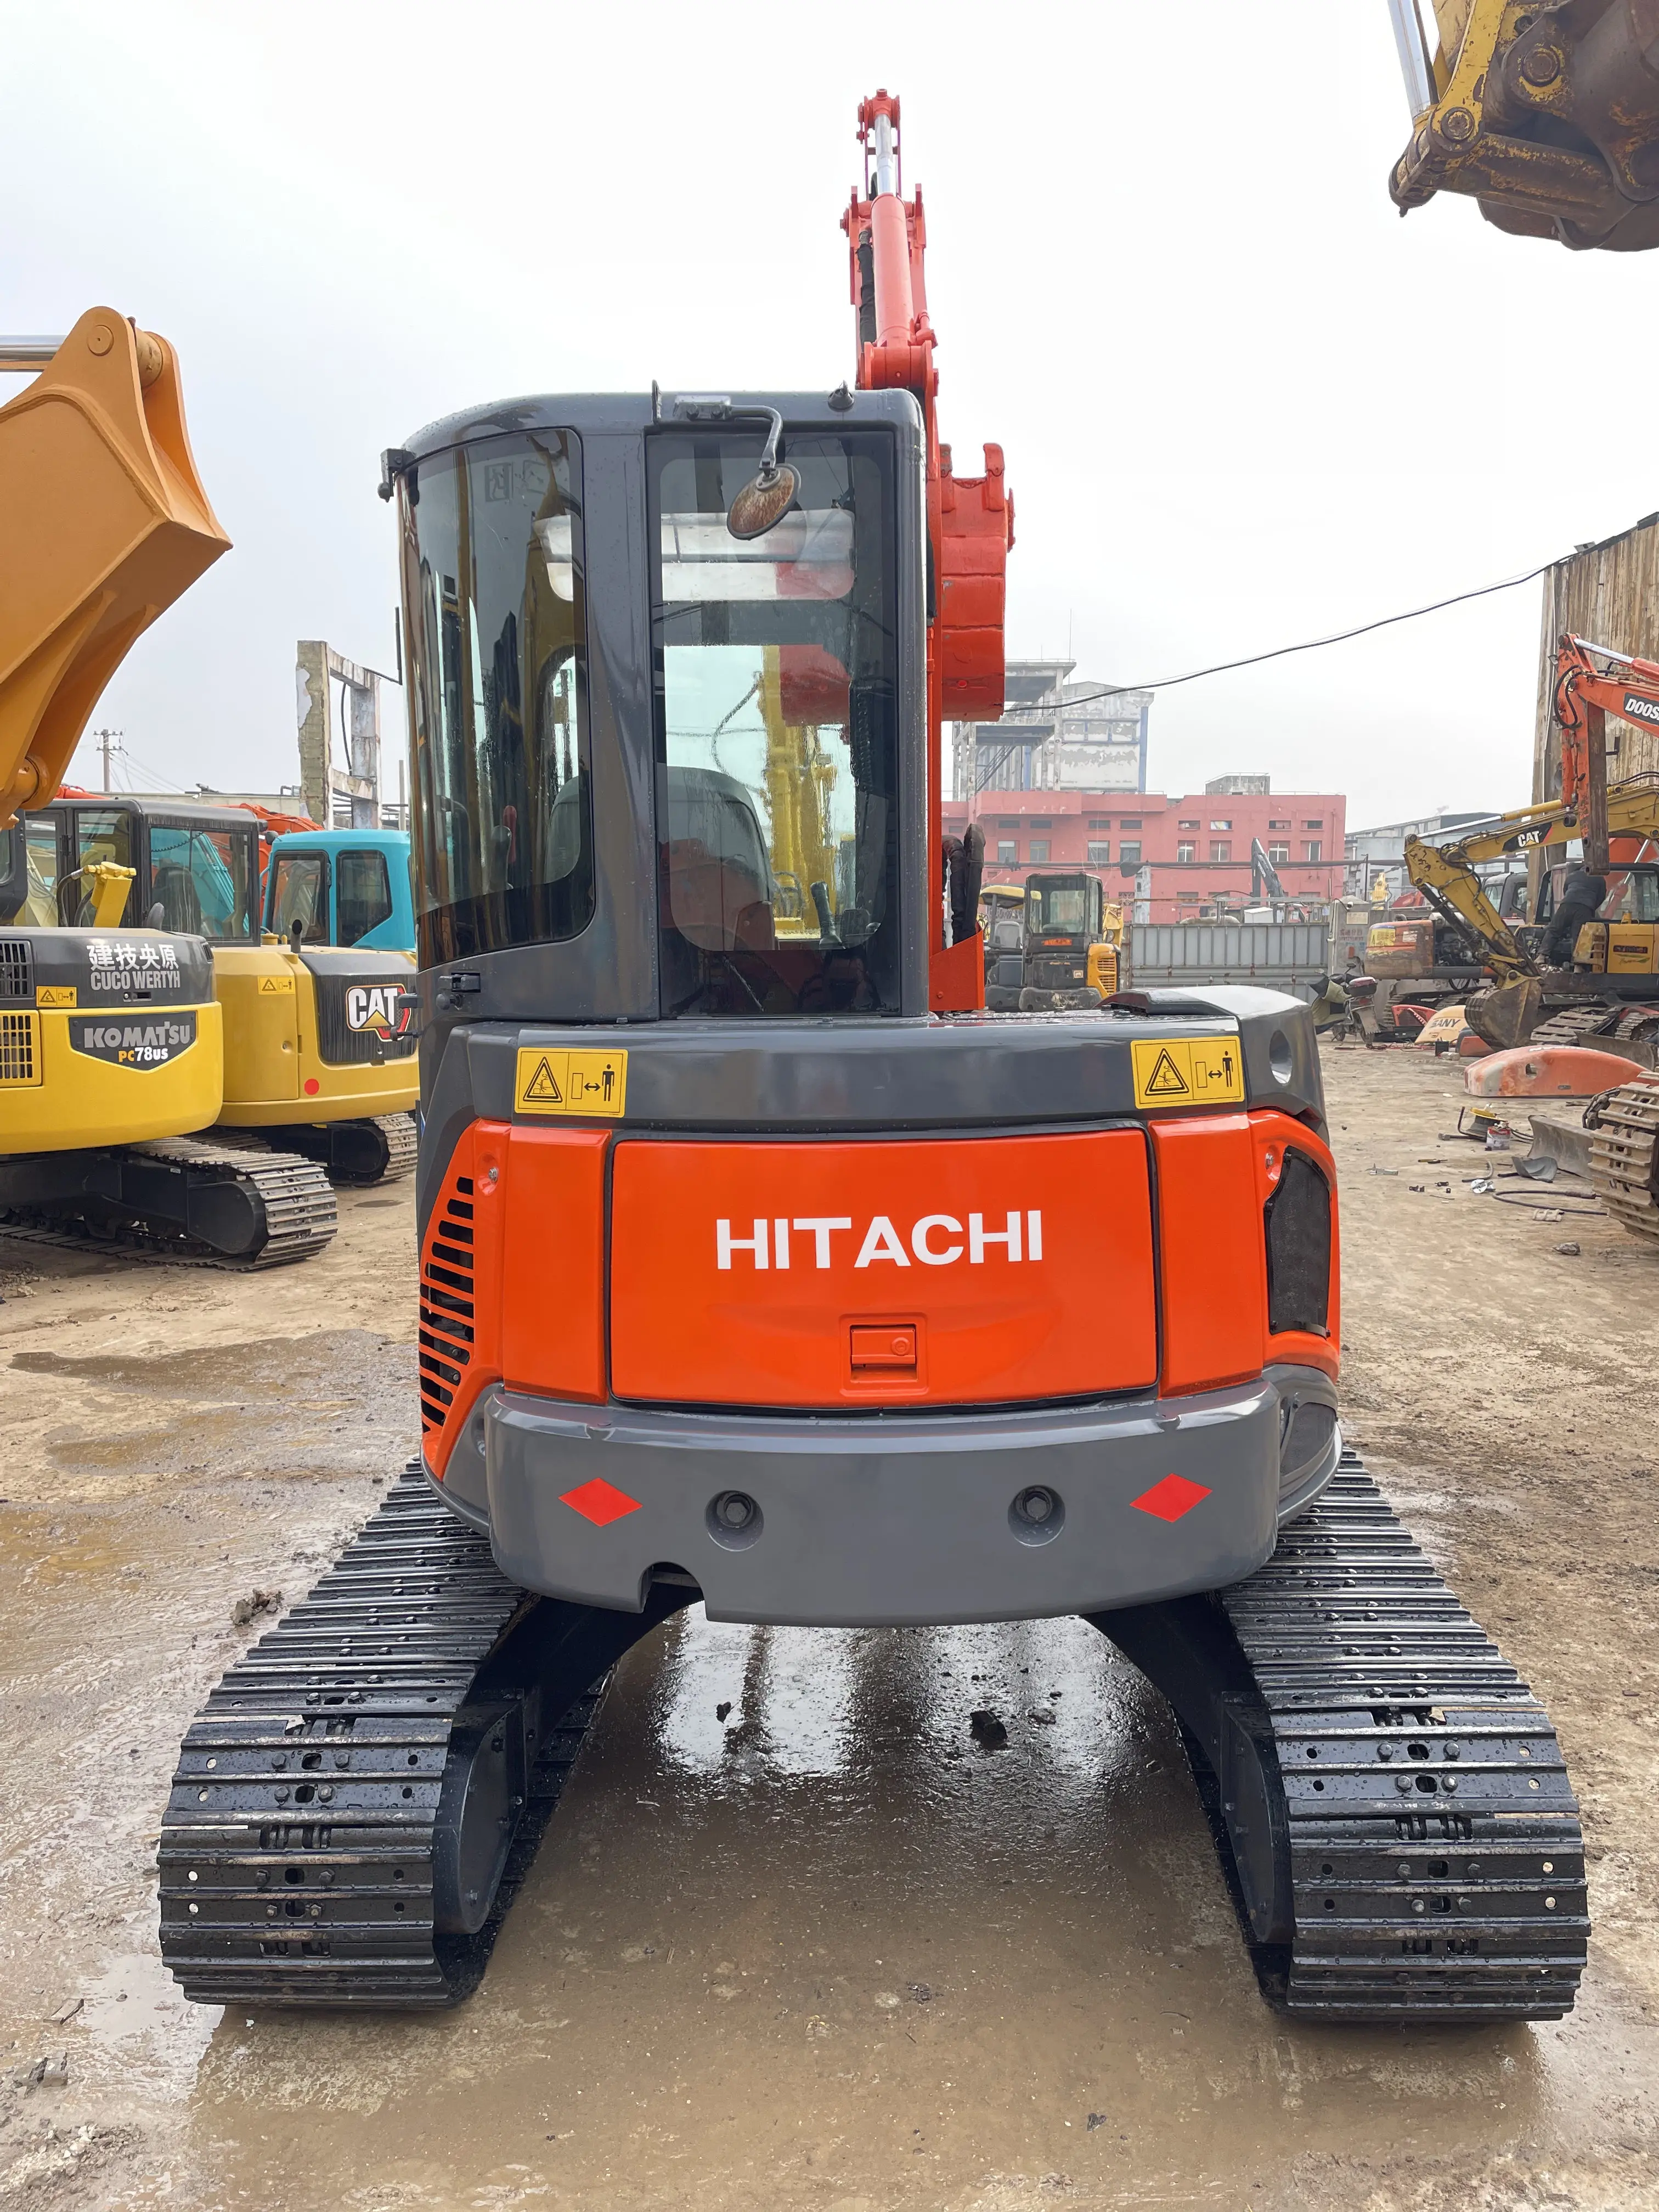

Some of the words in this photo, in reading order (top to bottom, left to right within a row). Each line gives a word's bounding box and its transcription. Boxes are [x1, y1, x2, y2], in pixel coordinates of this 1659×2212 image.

[1625, 698, 1659, 721] DOOS
[1517, 830, 1539, 847] CAT
[86, 943, 179, 971] 建技央原
[91, 971, 131, 990] CUCO
[132, 971, 180, 989] WERTYH
[348, 988, 398, 1028] CAT
[84, 1021, 190, 1048] KOMATSU
[1430, 1018, 1461, 1028] SANY
[118, 1047, 168, 1063] PC78US
[716, 1210, 1042, 1270] HITACHI
